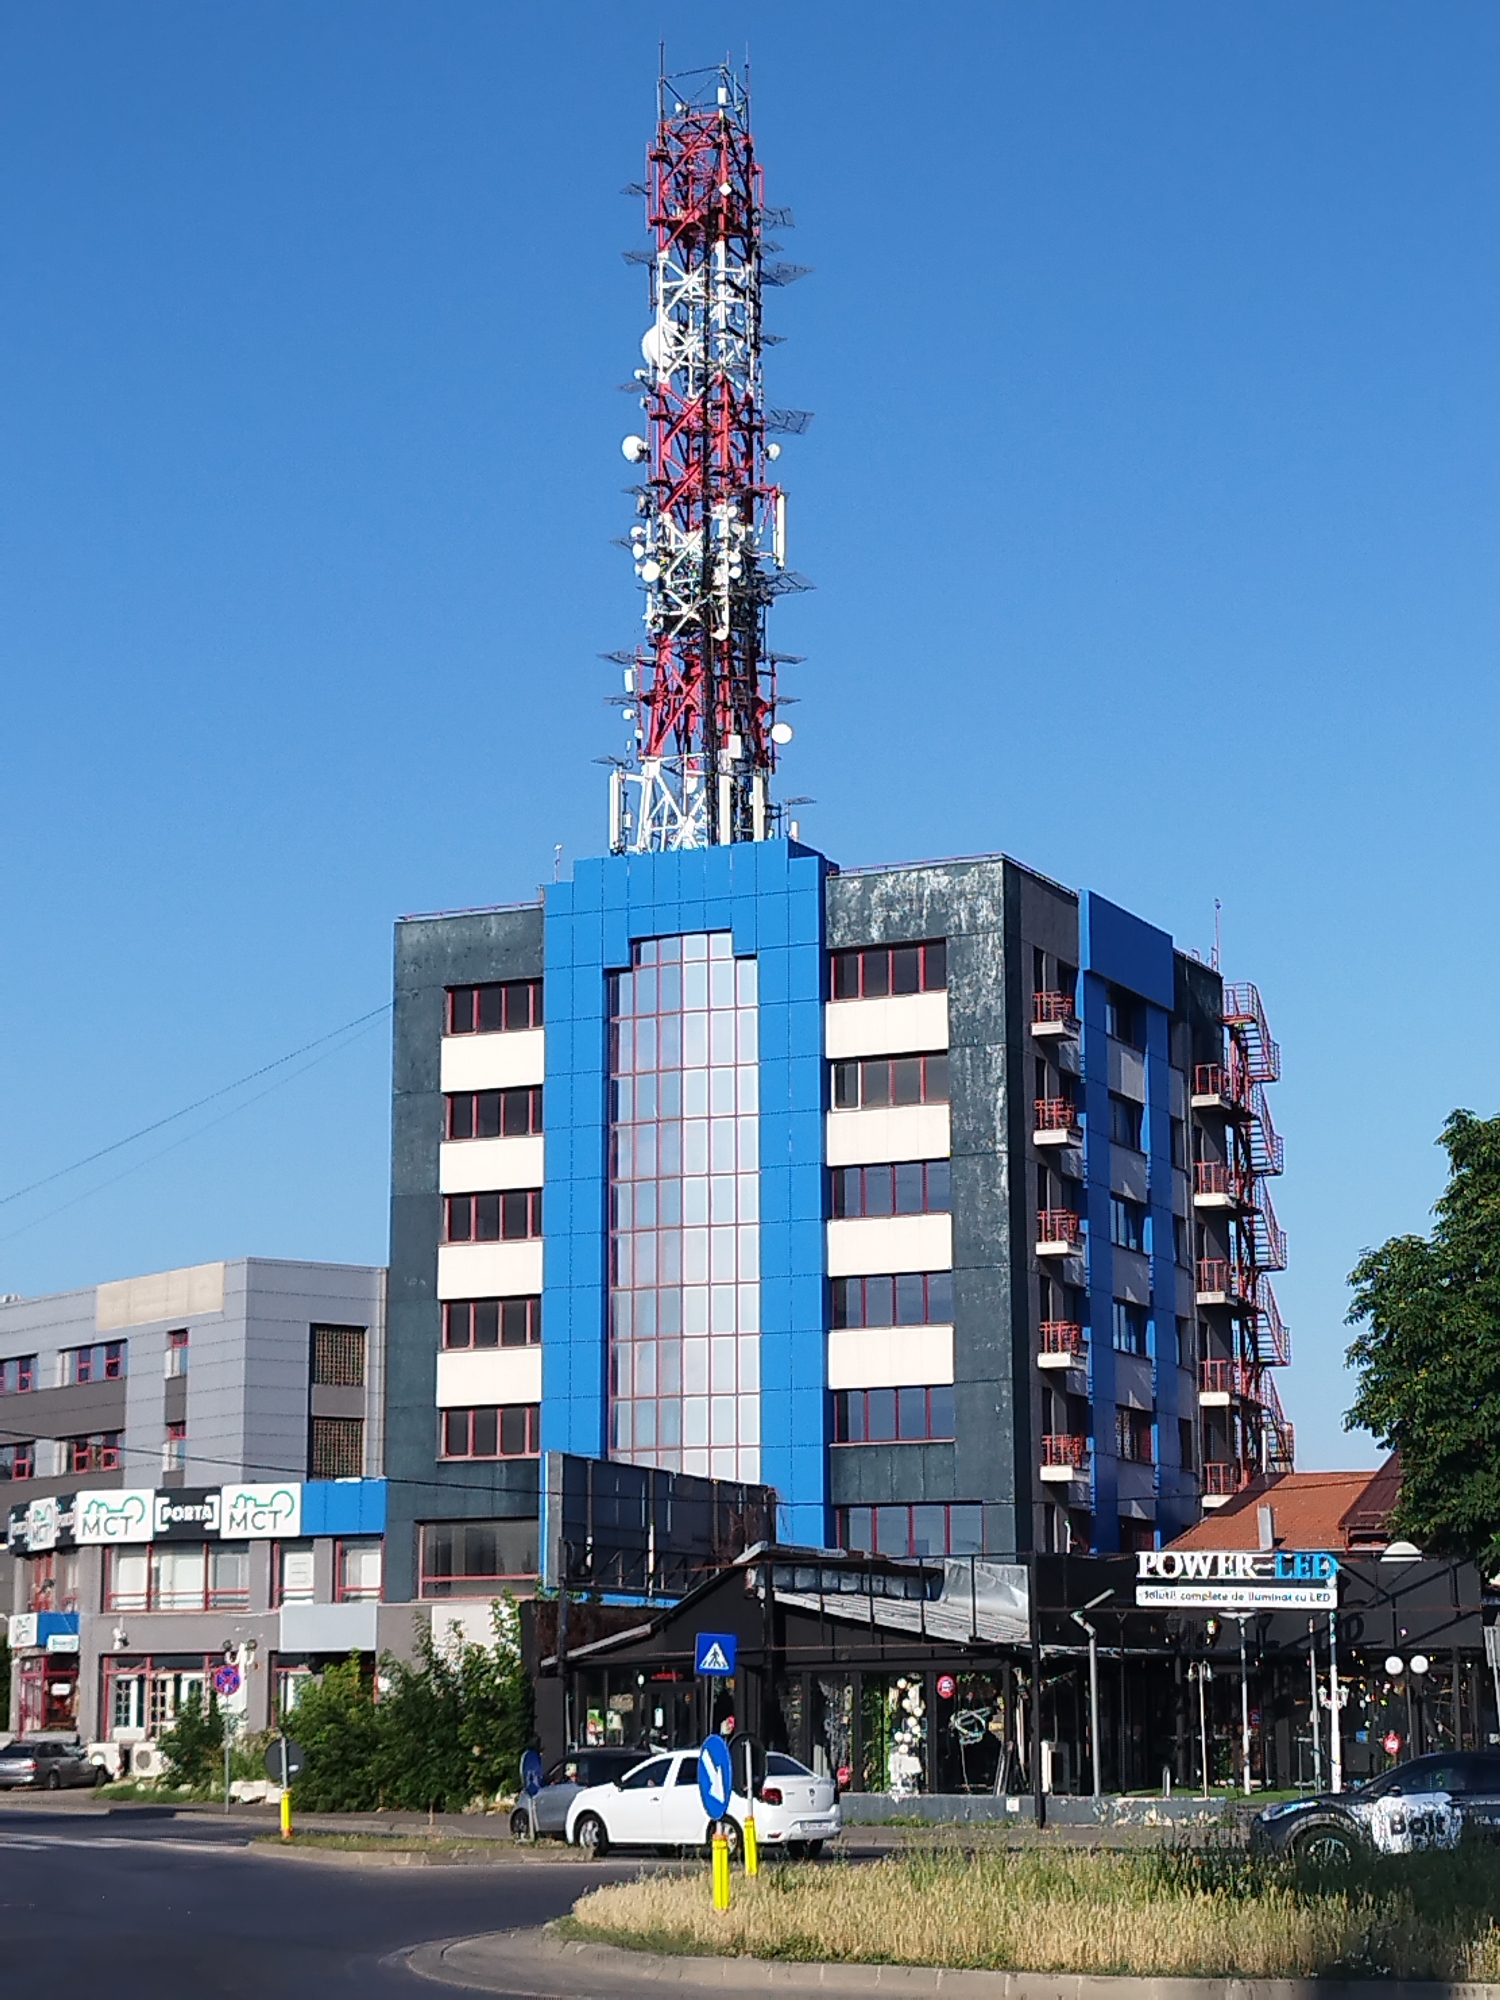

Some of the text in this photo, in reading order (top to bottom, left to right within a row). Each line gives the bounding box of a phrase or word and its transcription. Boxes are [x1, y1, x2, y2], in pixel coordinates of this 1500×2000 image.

[162, 1505, 213, 1523] PORTA
[229, 1509, 283, 1532] MCT
[82, 1515, 134, 1537] MCT
[1180, 1590, 1228, 1602] complete
[1232, 1591, 1245, 1601] de
[1295, 1594, 1307, 1602] cu
[1310, 1591, 1331, 1602] LED
